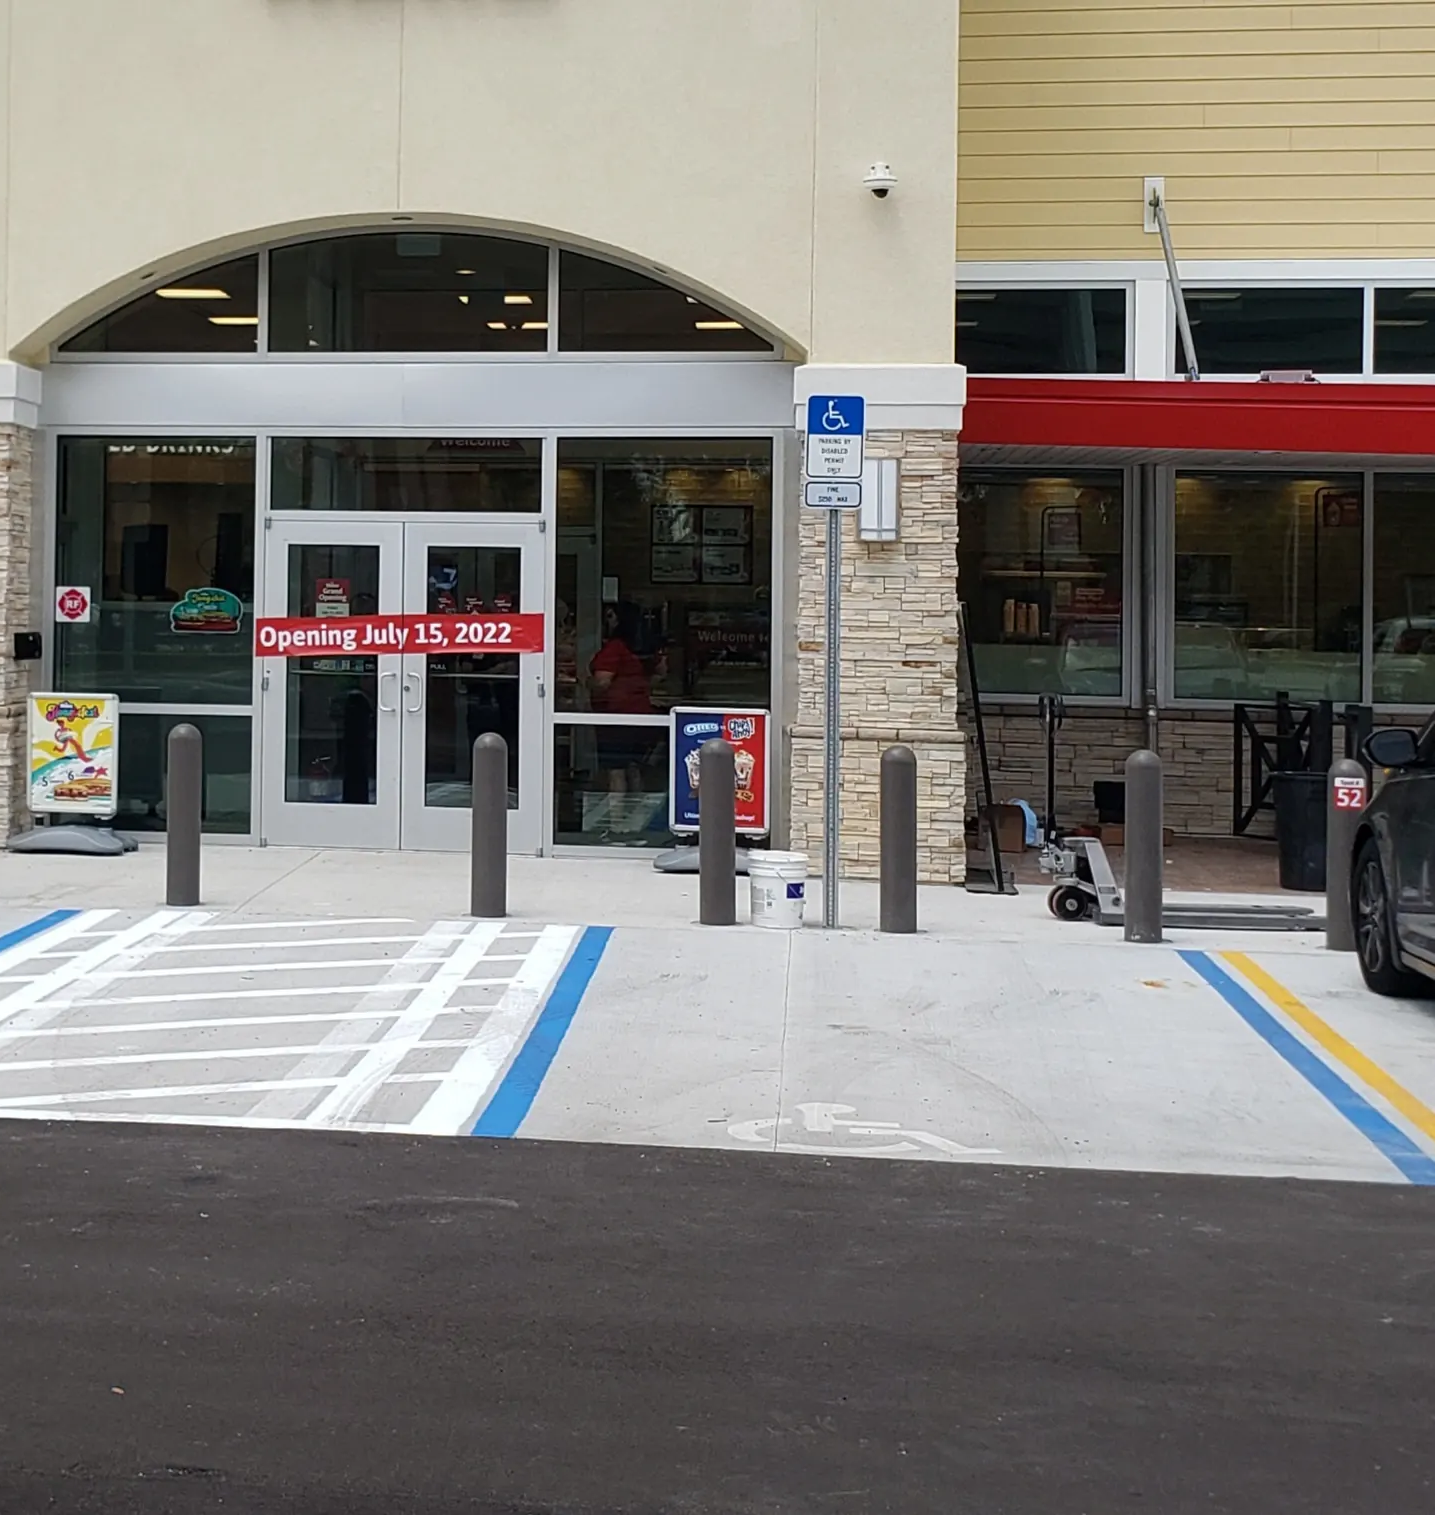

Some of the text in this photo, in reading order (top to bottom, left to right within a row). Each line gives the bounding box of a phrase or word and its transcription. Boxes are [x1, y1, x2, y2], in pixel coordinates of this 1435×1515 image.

[66, 599, 80, 610] RF
[259, 621, 513, 653] Opening July 15, 2022
[697, 630, 755, 643] Welcome
[1336, 788, 1362, 808] 52
